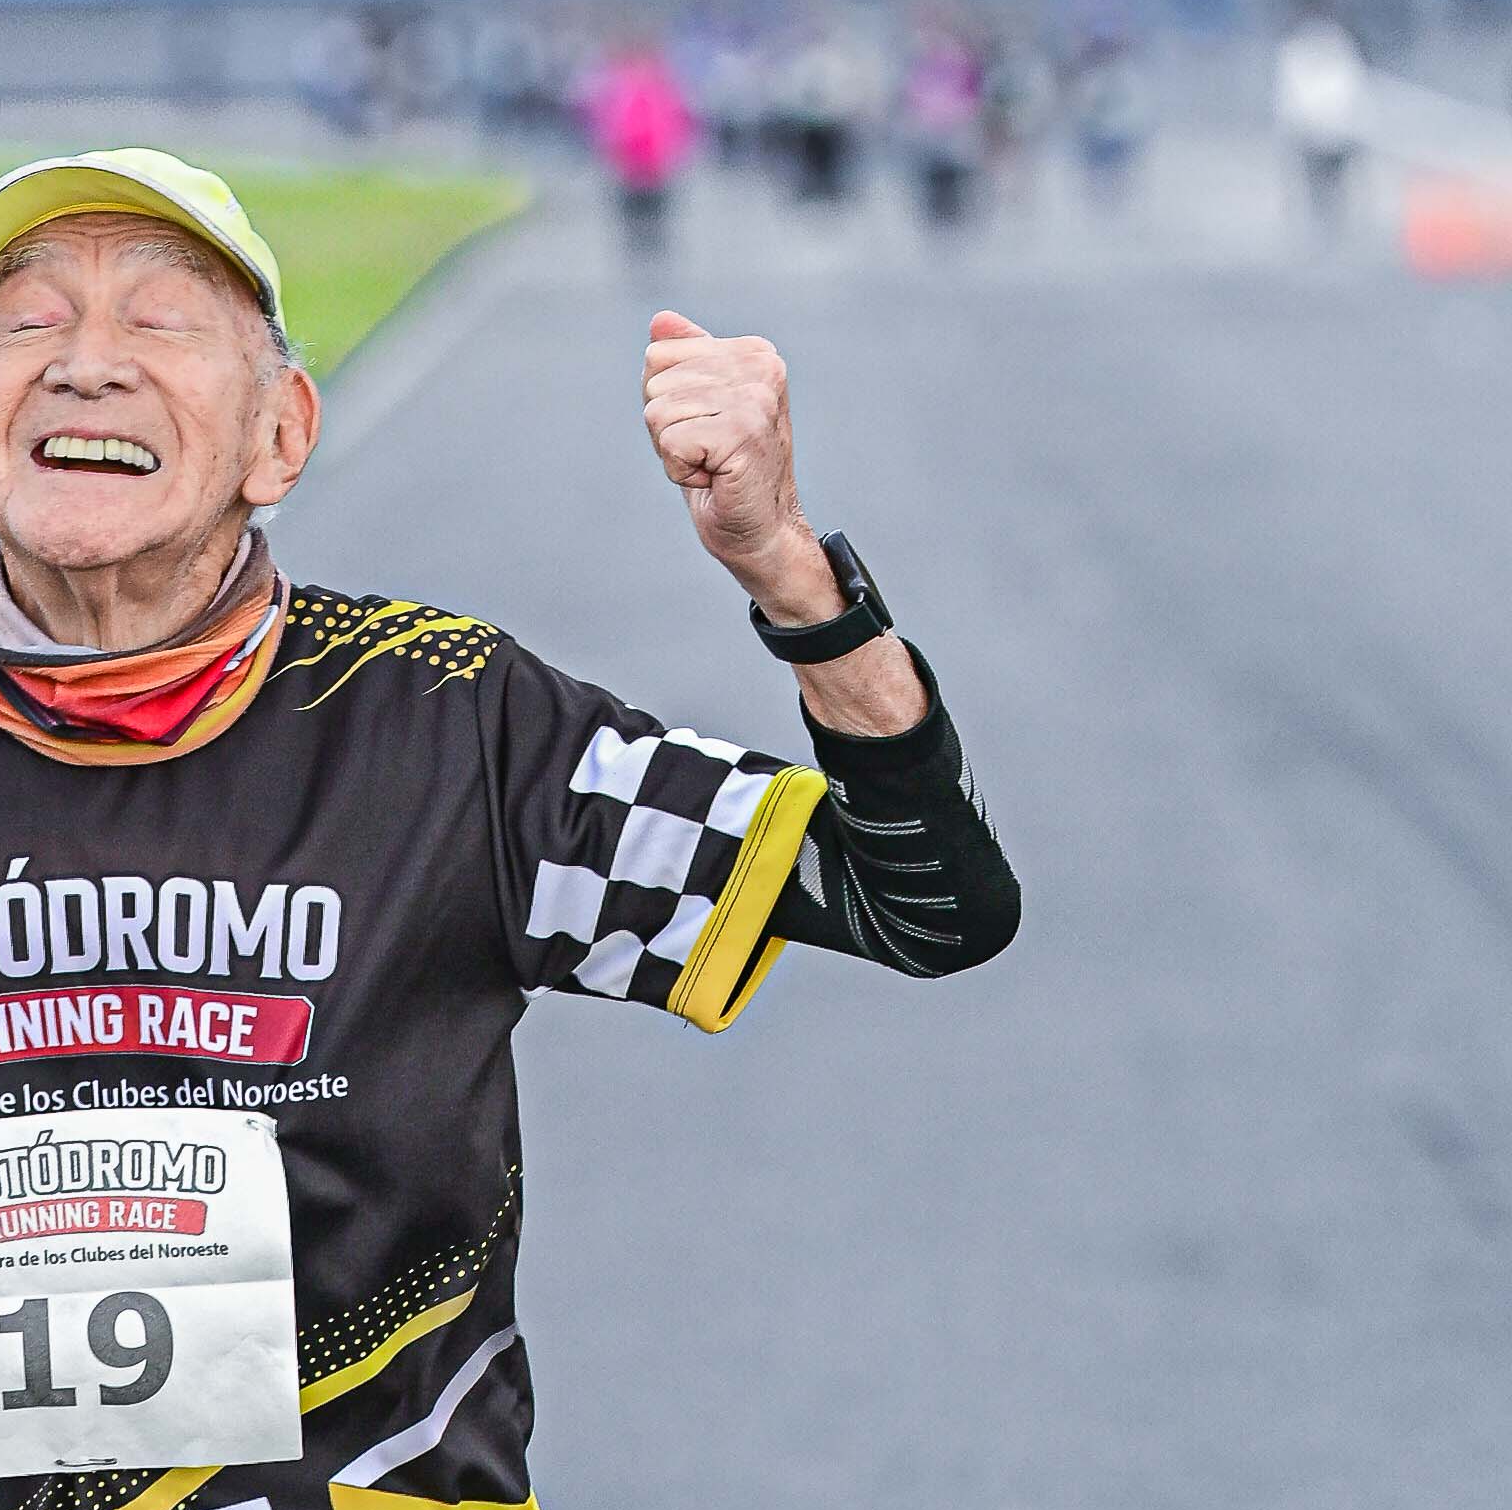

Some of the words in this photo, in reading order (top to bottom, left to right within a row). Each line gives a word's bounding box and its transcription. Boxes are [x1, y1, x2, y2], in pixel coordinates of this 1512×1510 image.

[138, 994, 258, 1058] RACE
[22, 1083, 66, 1112] los
[72, 1078, 169, 1109] Clubes
[175, 1077, 215, 1107] del
[222, 1073, 349, 1108] Noroeste
[108, 1200, 177, 1230] RACE
[18, 1251, 40, 1267] de
[44, 1248, 67, 1264] los
[71, 1246, 126, 1263] Clubes
[130, 1243, 155, 1260] del
[158, 1241, 230, 1259] Noroeste
